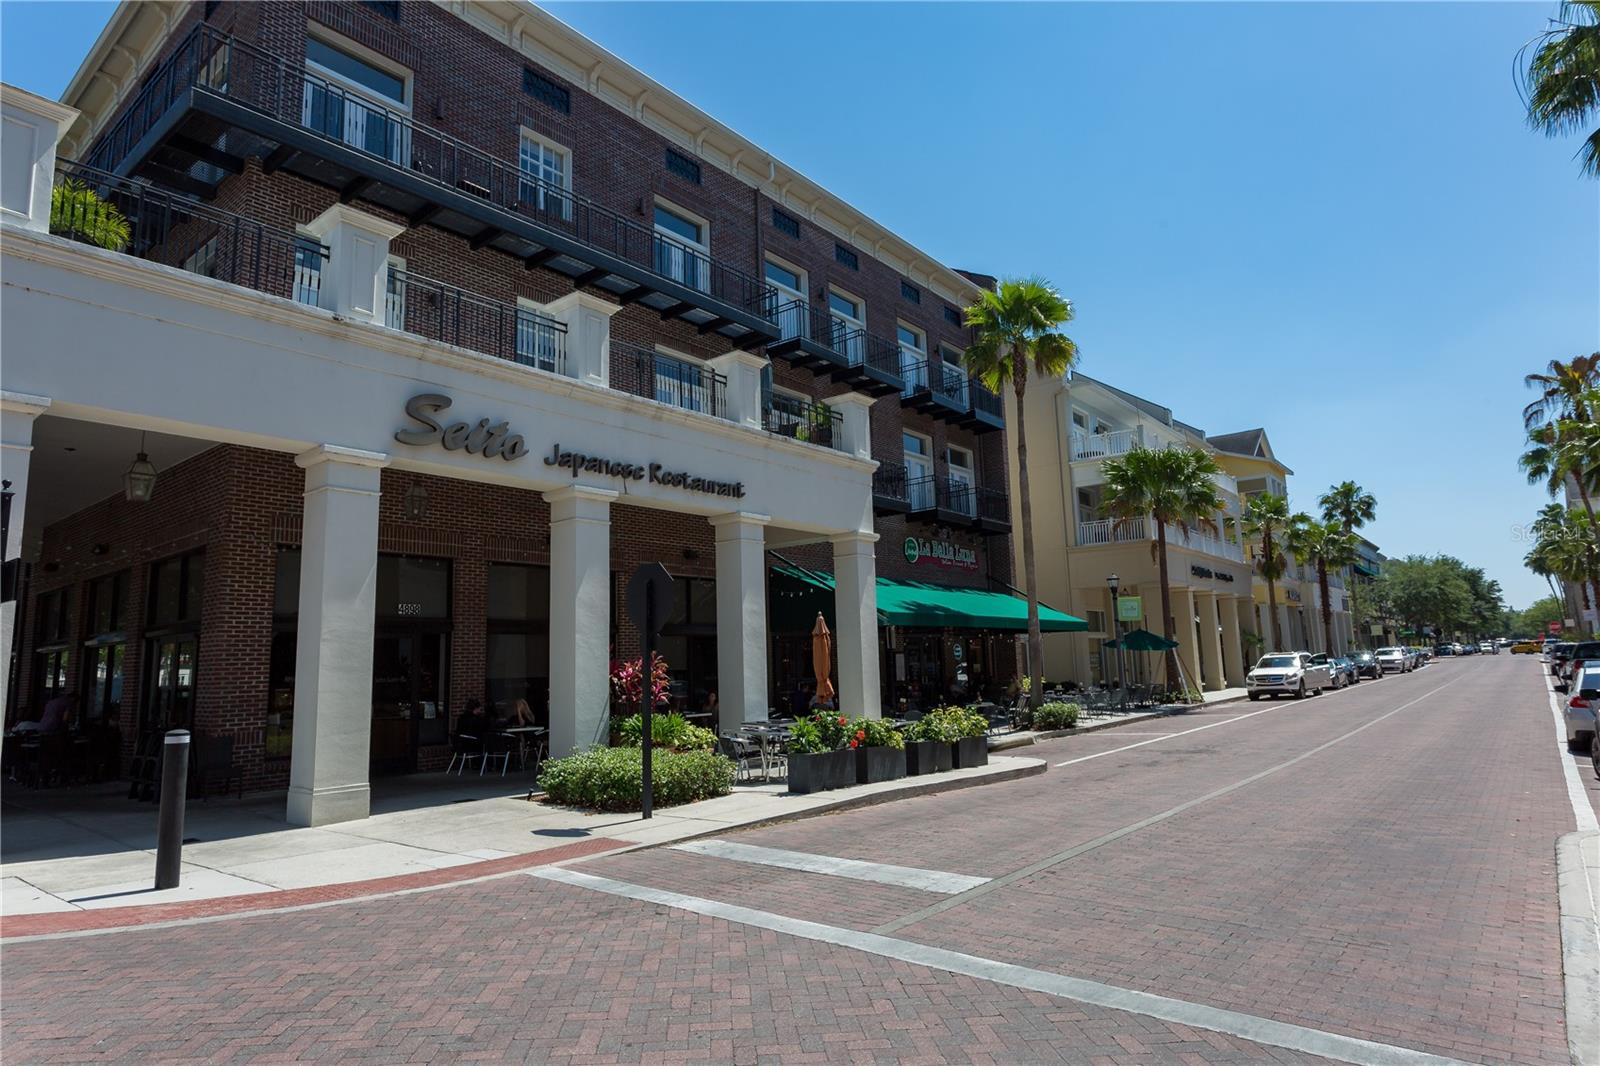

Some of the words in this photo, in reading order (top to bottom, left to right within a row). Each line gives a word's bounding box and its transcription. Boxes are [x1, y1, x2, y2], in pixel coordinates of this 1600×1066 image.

[394, 393, 530, 461] Seito
[543, 443, 645, 480] Japanese
[648, 462, 746, 499] Restaurant
